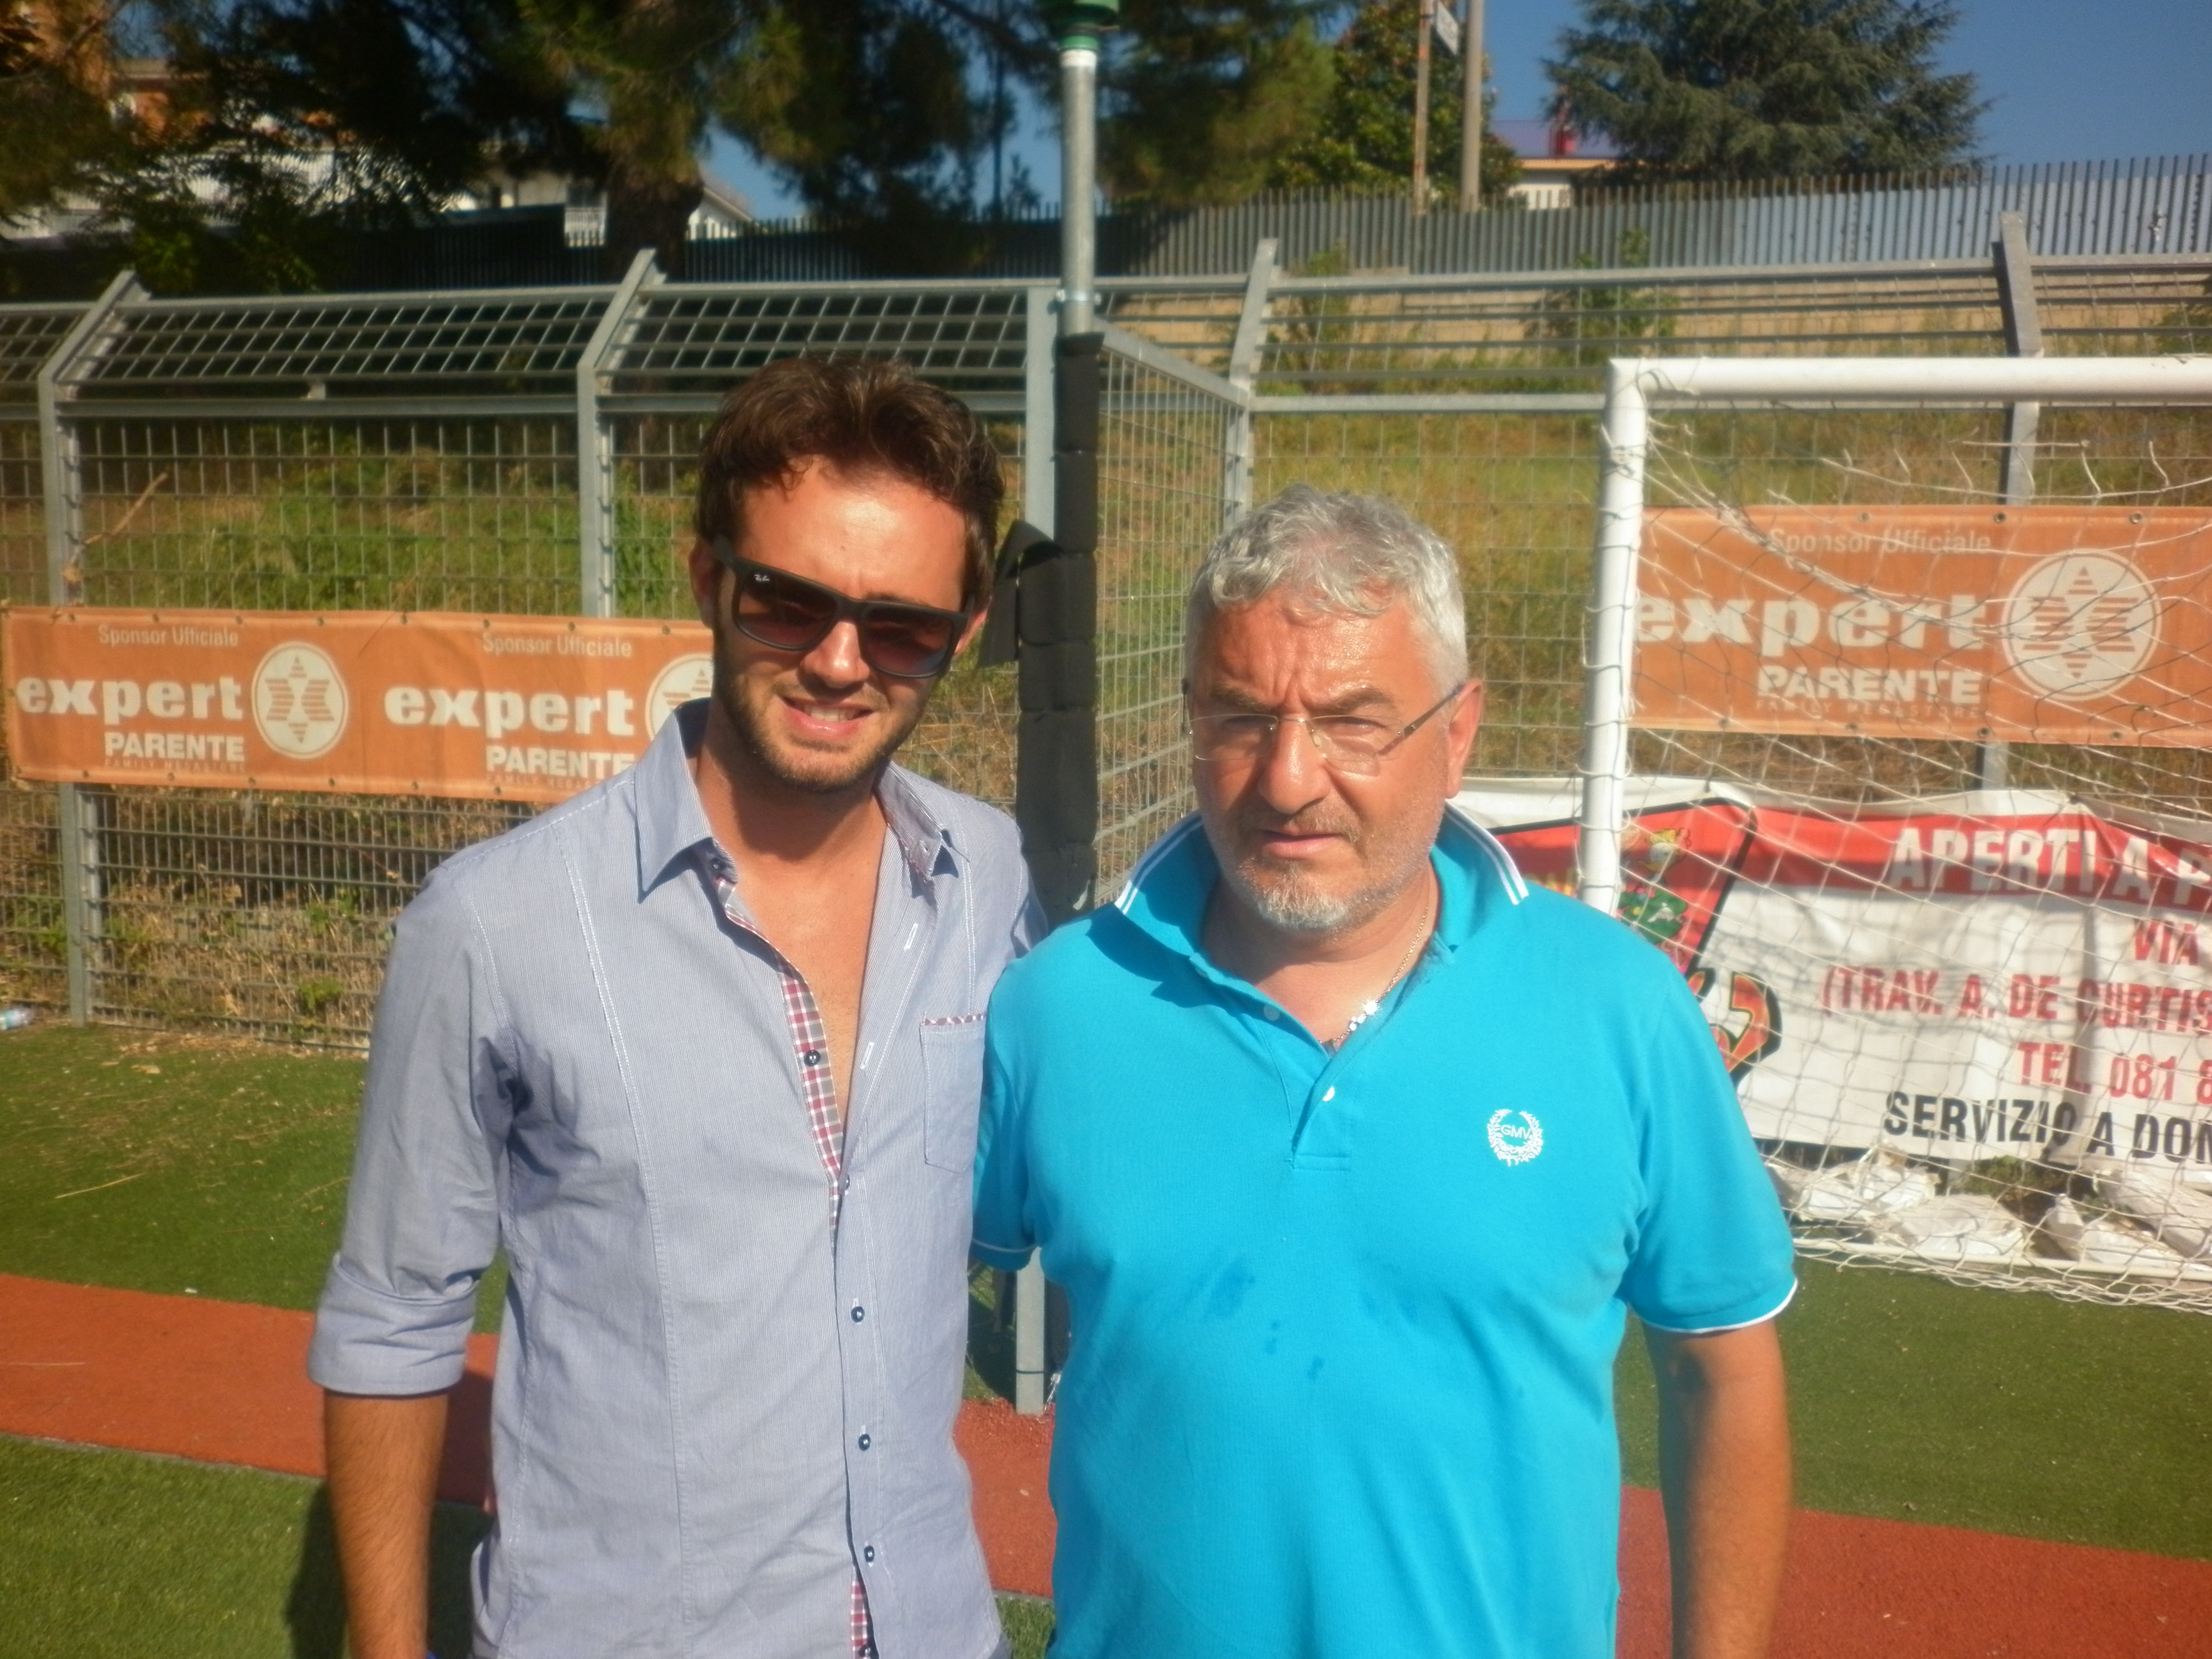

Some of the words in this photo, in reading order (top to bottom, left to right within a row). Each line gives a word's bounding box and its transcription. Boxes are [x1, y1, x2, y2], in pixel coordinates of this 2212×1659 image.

[1768, 528, 1872, 552] Sponsor
[1881, 526, 1991, 553] Ufficiale
[98, 625, 167, 645] Sponsor
[173, 626, 239, 647] Ufficiale
[483, 633, 552, 654] Sponsor
[557, 636, 632, 657] Ufficiale
[15, 677, 243, 726] expert
[1757, 665, 1981, 705] PARENTE
[384, 686, 637, 739] expert
[104, 732, 245, 762] PARENTE
[1887, 827, 2098, 893] APERTI
[2133, 919, 2199, 966] VIA
[2008, 973, 2060, 1020] DE
[2109, 1054, 2177, 1100] 081
[1882, 1091, 2077, 1146] SERVIZIO
[2086, 1112, 2115, 1157] A
